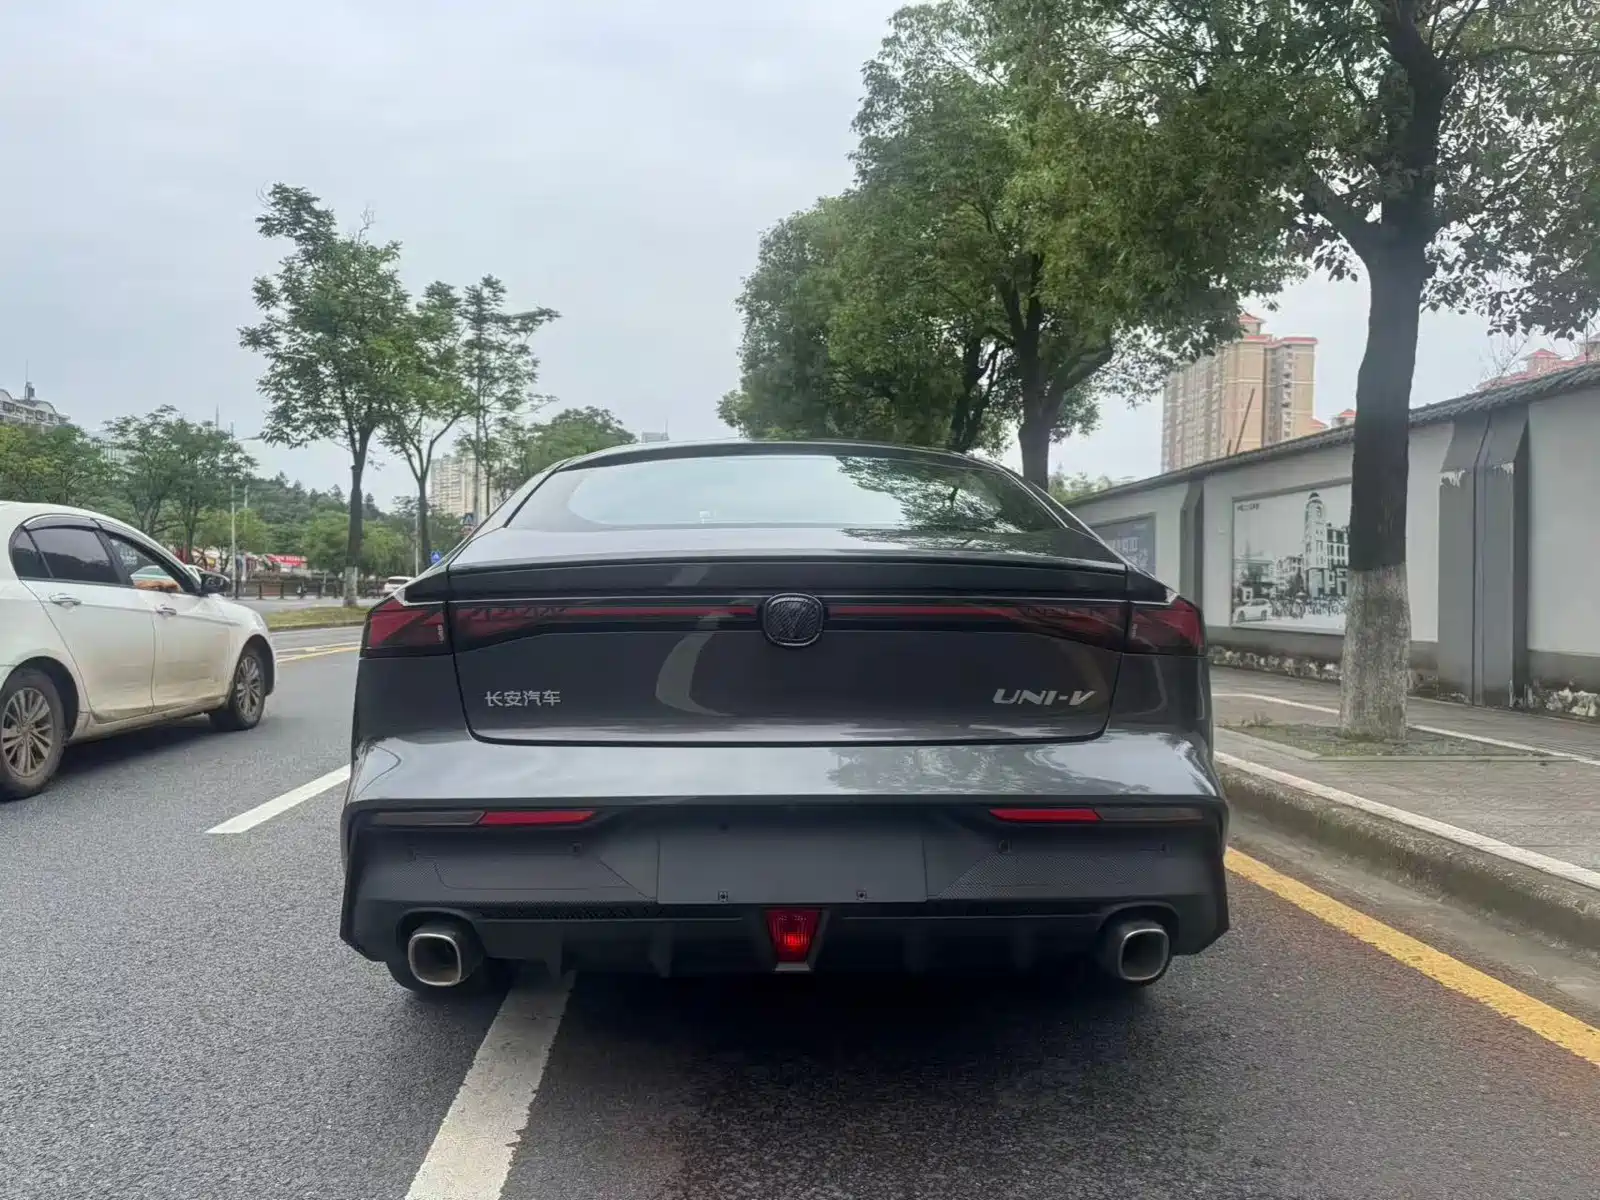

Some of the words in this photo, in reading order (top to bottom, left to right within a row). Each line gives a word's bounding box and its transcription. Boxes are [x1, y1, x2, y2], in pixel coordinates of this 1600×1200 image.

[484, 690, 561, 706] 长安汽车
[992, 688, 1096, 706] UNI-V
